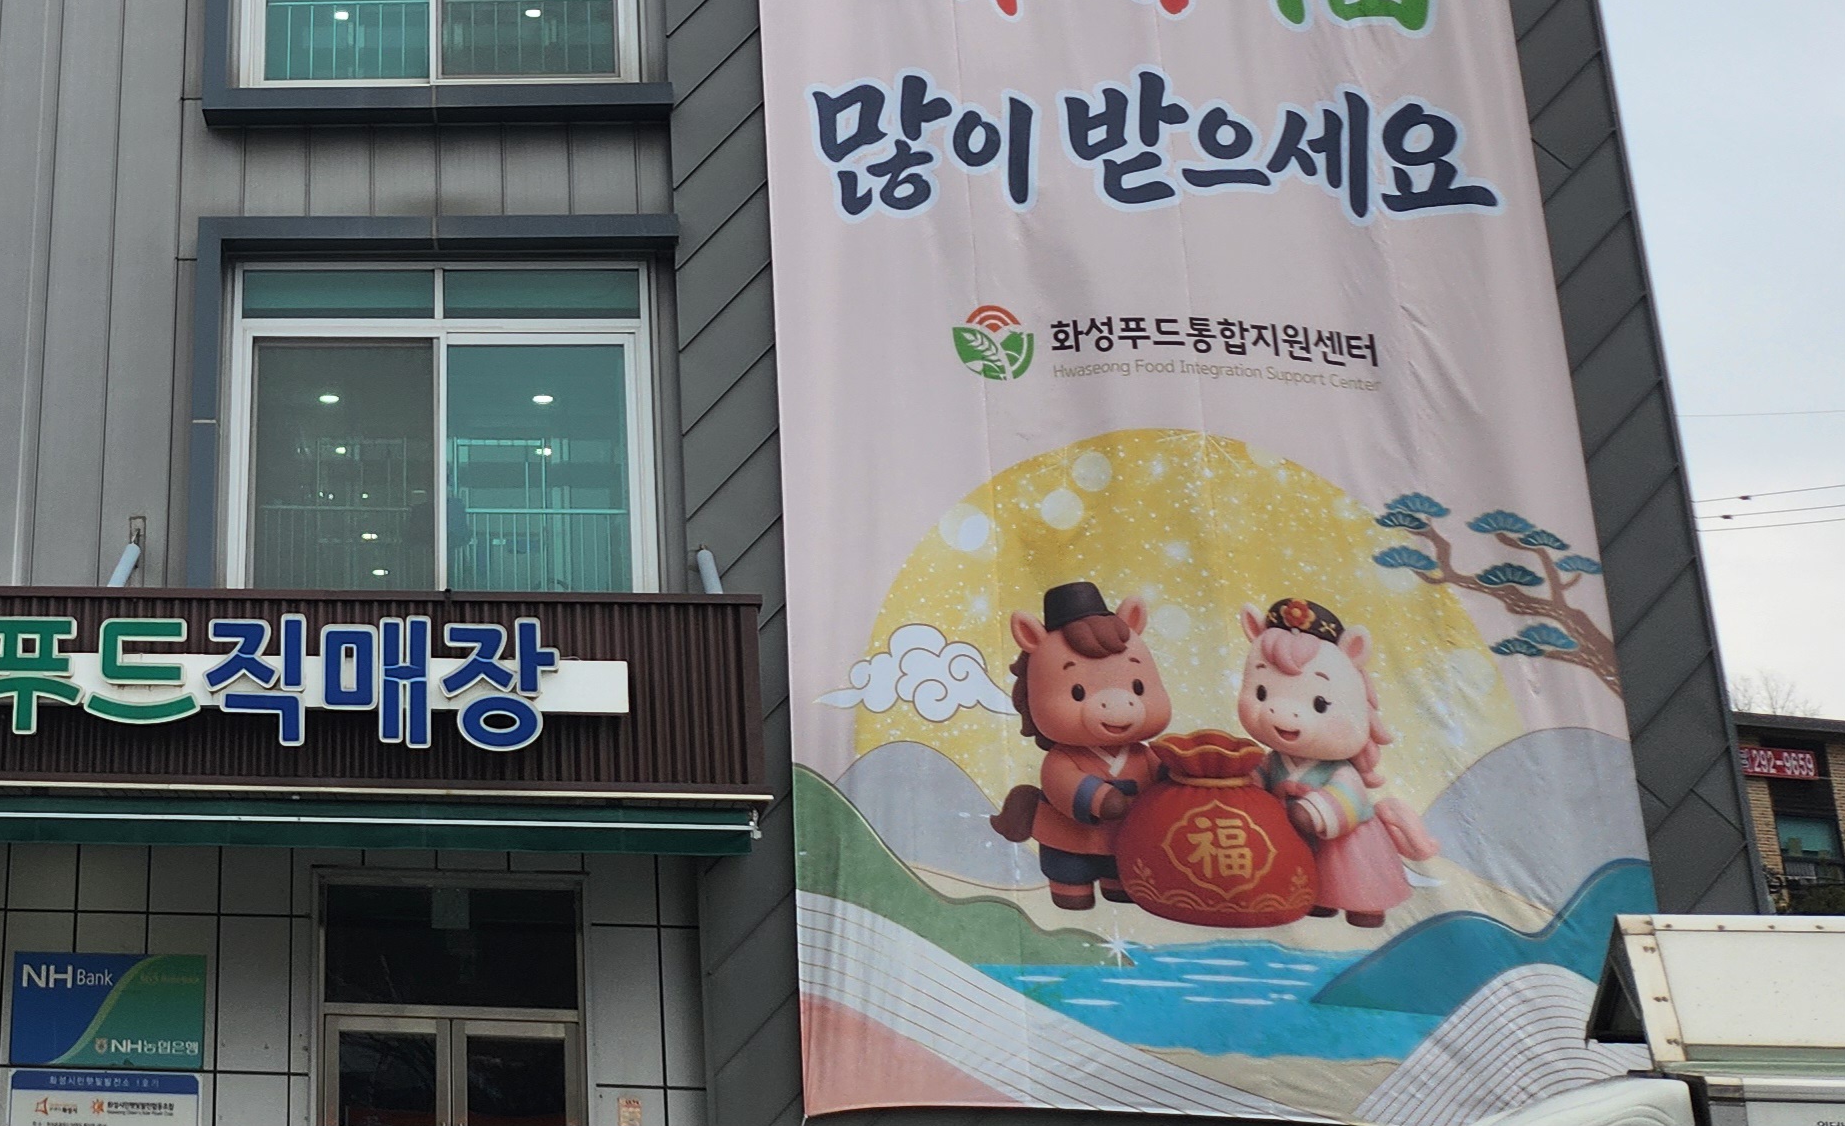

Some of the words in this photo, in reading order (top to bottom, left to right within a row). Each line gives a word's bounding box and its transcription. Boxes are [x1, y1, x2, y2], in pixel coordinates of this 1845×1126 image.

[810, 73, 1034, 214] 많이
[1063, 72, 1501, 219] 받으세요
[1050, 315, 1380, 368] 화성푸드통합지원센터
[1052, 359, 1131, 378] Hwaseong
[1134, 358, 1176, 374] Food
[1179, 359, 1264, 380] Integration
[1266, 366, 1326, 387] Support
[1330, 373, 1383, 392] Center
[1186, 816, 1253, 879] 福
[21, 963, 74, 989] NH
[76, 968, 114, 987] Bank
[110, 1038, 199, 1055] NH농협은행
